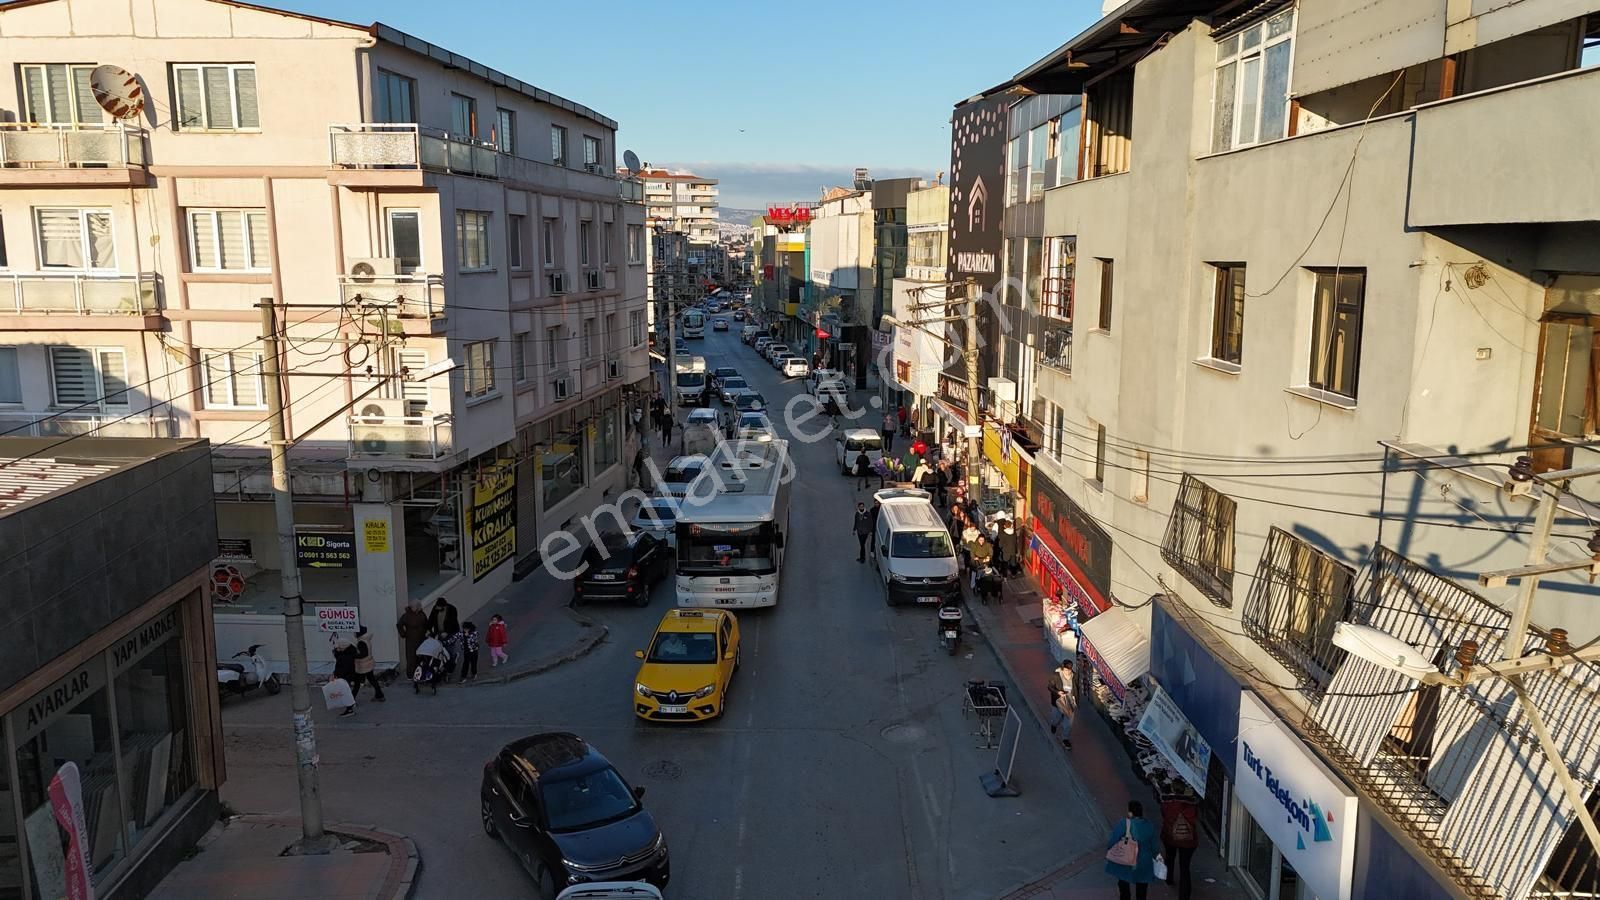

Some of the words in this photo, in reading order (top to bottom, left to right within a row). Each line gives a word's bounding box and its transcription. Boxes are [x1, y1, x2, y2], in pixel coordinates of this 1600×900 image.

[957, 249, 995, 273] PAZARİZM
[326, 540, 350, 549] Sigorta
[473, 510, 514, 547] KİRALIK
[113, 636, 138, 668] YAPI
[138, 609, 178, 650] MARKET
[27, 670, 89, 731] AVARLAR
[1242, 740, 1263, 780] Türk
[1264, 766, 1310, 833] Telekom
